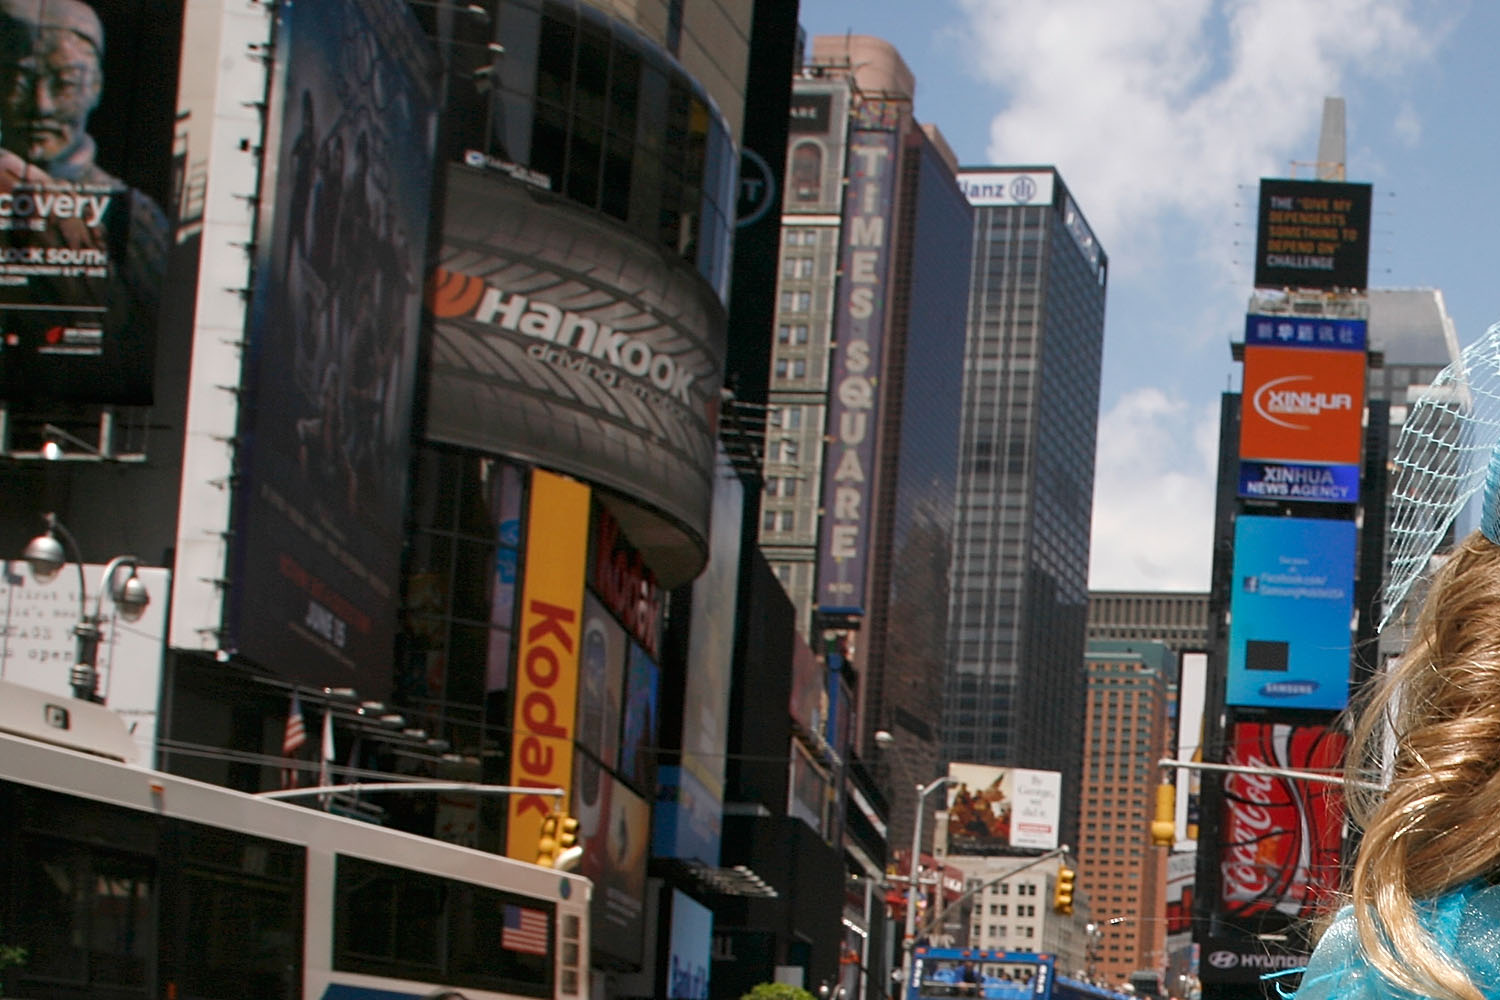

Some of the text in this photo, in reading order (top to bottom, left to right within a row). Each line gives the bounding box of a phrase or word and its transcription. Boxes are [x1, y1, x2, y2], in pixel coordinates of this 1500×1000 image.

[849, 146, 888, 319] TIMES
[47, 248, 107, 265] SOUTH
[1266, 254, 1335, 270] CHALLENGE
[831, 340, 874, 560] SQUARE
[1264, 466, 1334, 485] XINHUA
[1247, 482, 1350, 498] NEWS AGENCY
[516, 599, 577, 818] Kodak
[1240, 953, 1309, 969] HYUNDA
